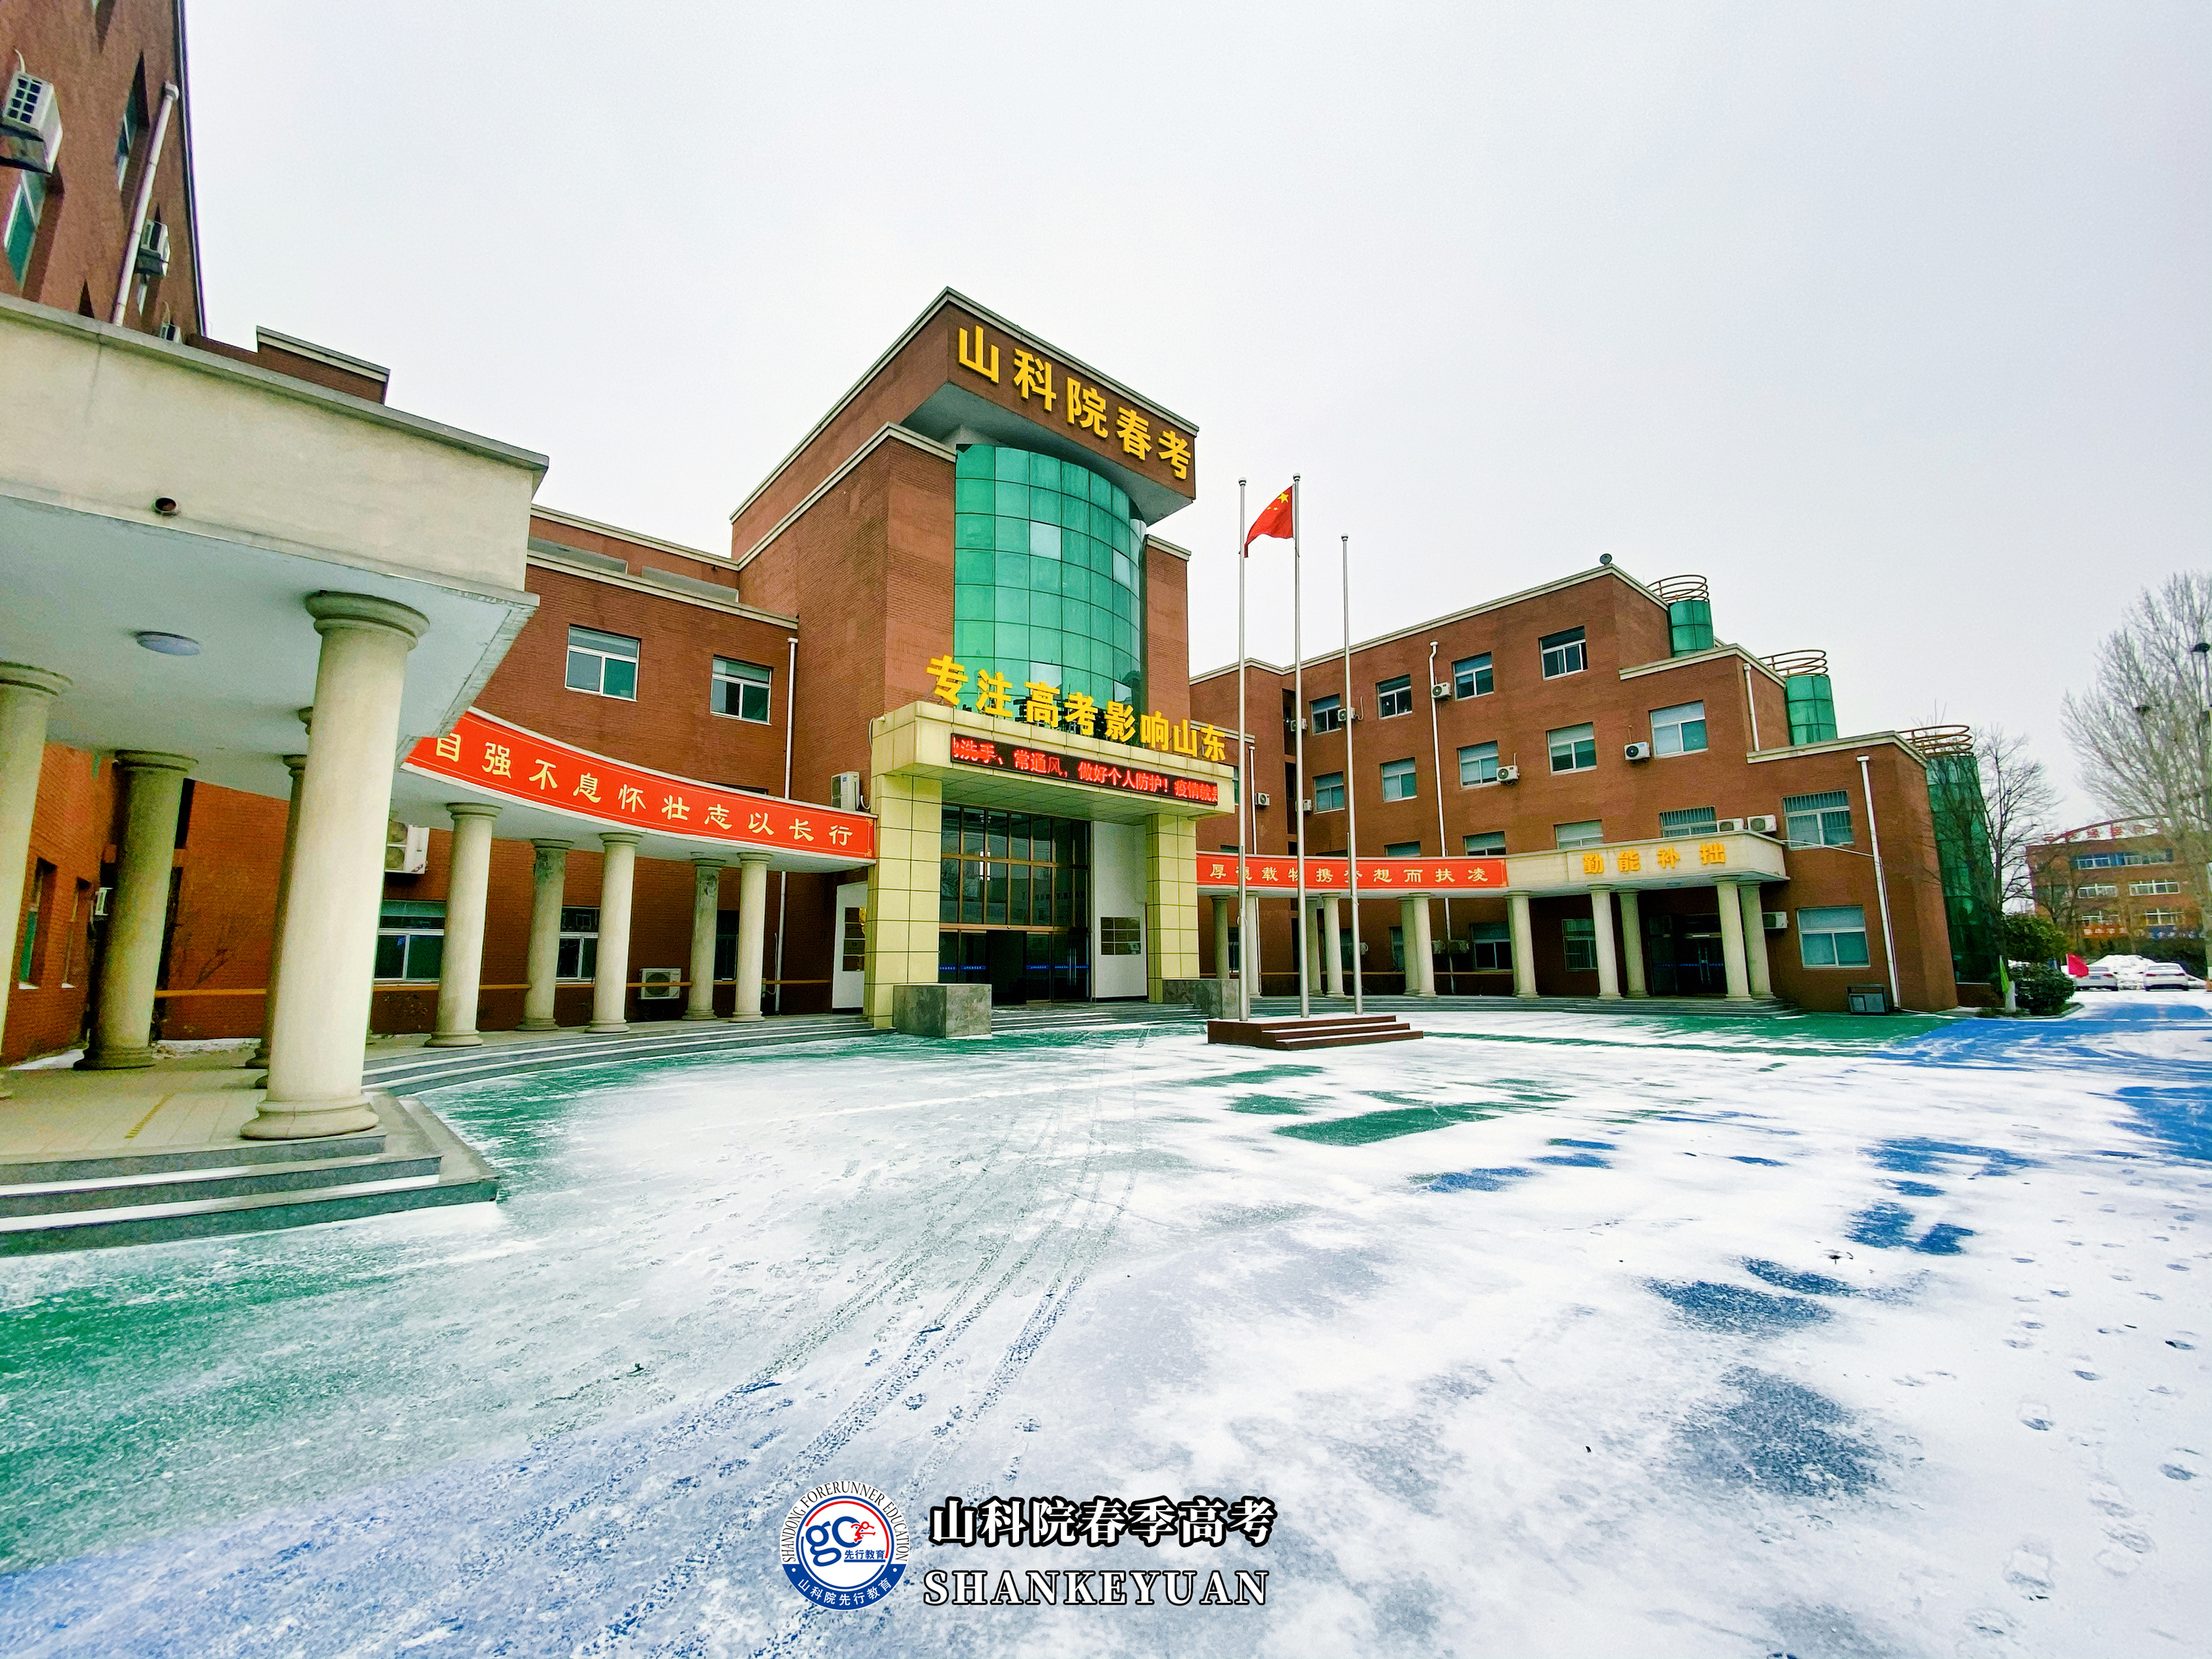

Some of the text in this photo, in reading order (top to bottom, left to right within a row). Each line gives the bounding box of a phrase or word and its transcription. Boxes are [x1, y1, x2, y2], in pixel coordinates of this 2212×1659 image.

[958, 324, 1192, 480] 山科院春考
[926, 654, 1226, 762] 专注高考影响山东
[434, 731, 854, 847] 自强不息怀壮志以长行
[1582, 842, 1727, 874] 勤能补拙
